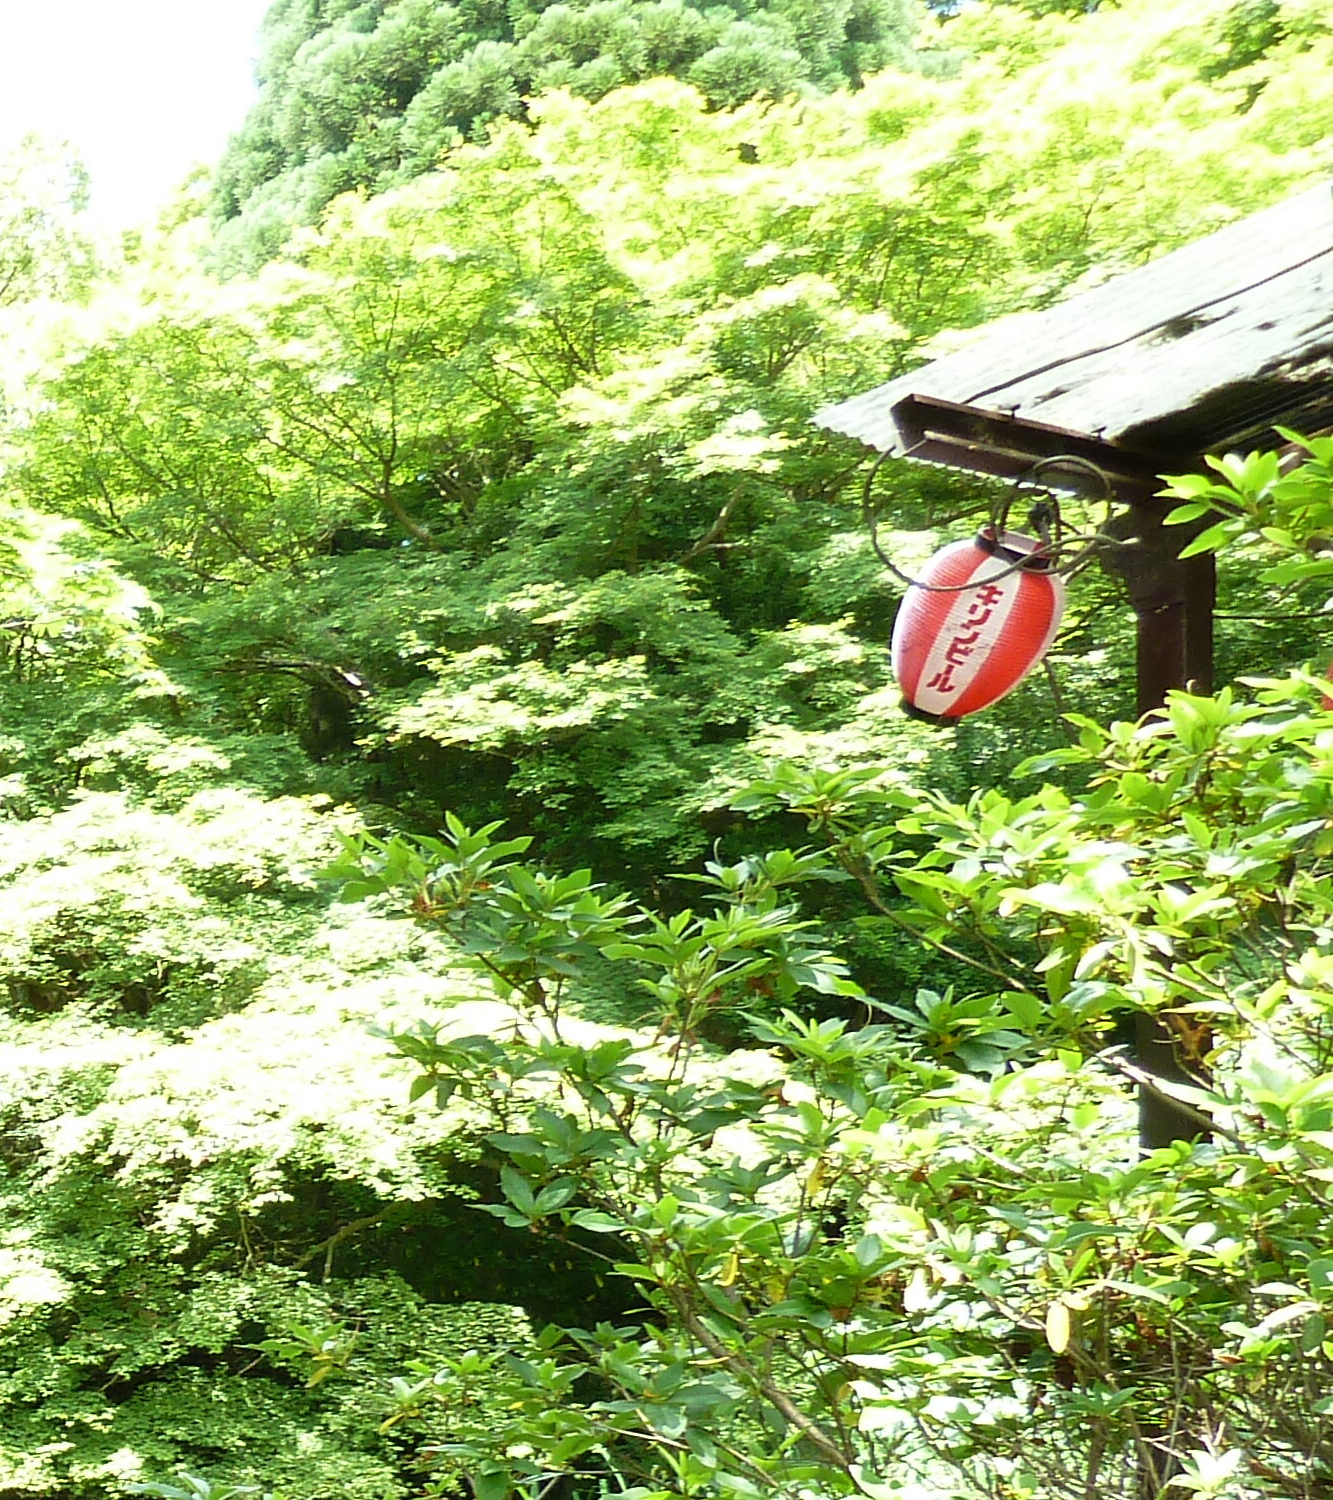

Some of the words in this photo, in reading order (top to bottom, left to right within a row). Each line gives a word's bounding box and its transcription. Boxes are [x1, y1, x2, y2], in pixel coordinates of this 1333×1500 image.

[925, 584, 1004, 693] キリンビール
